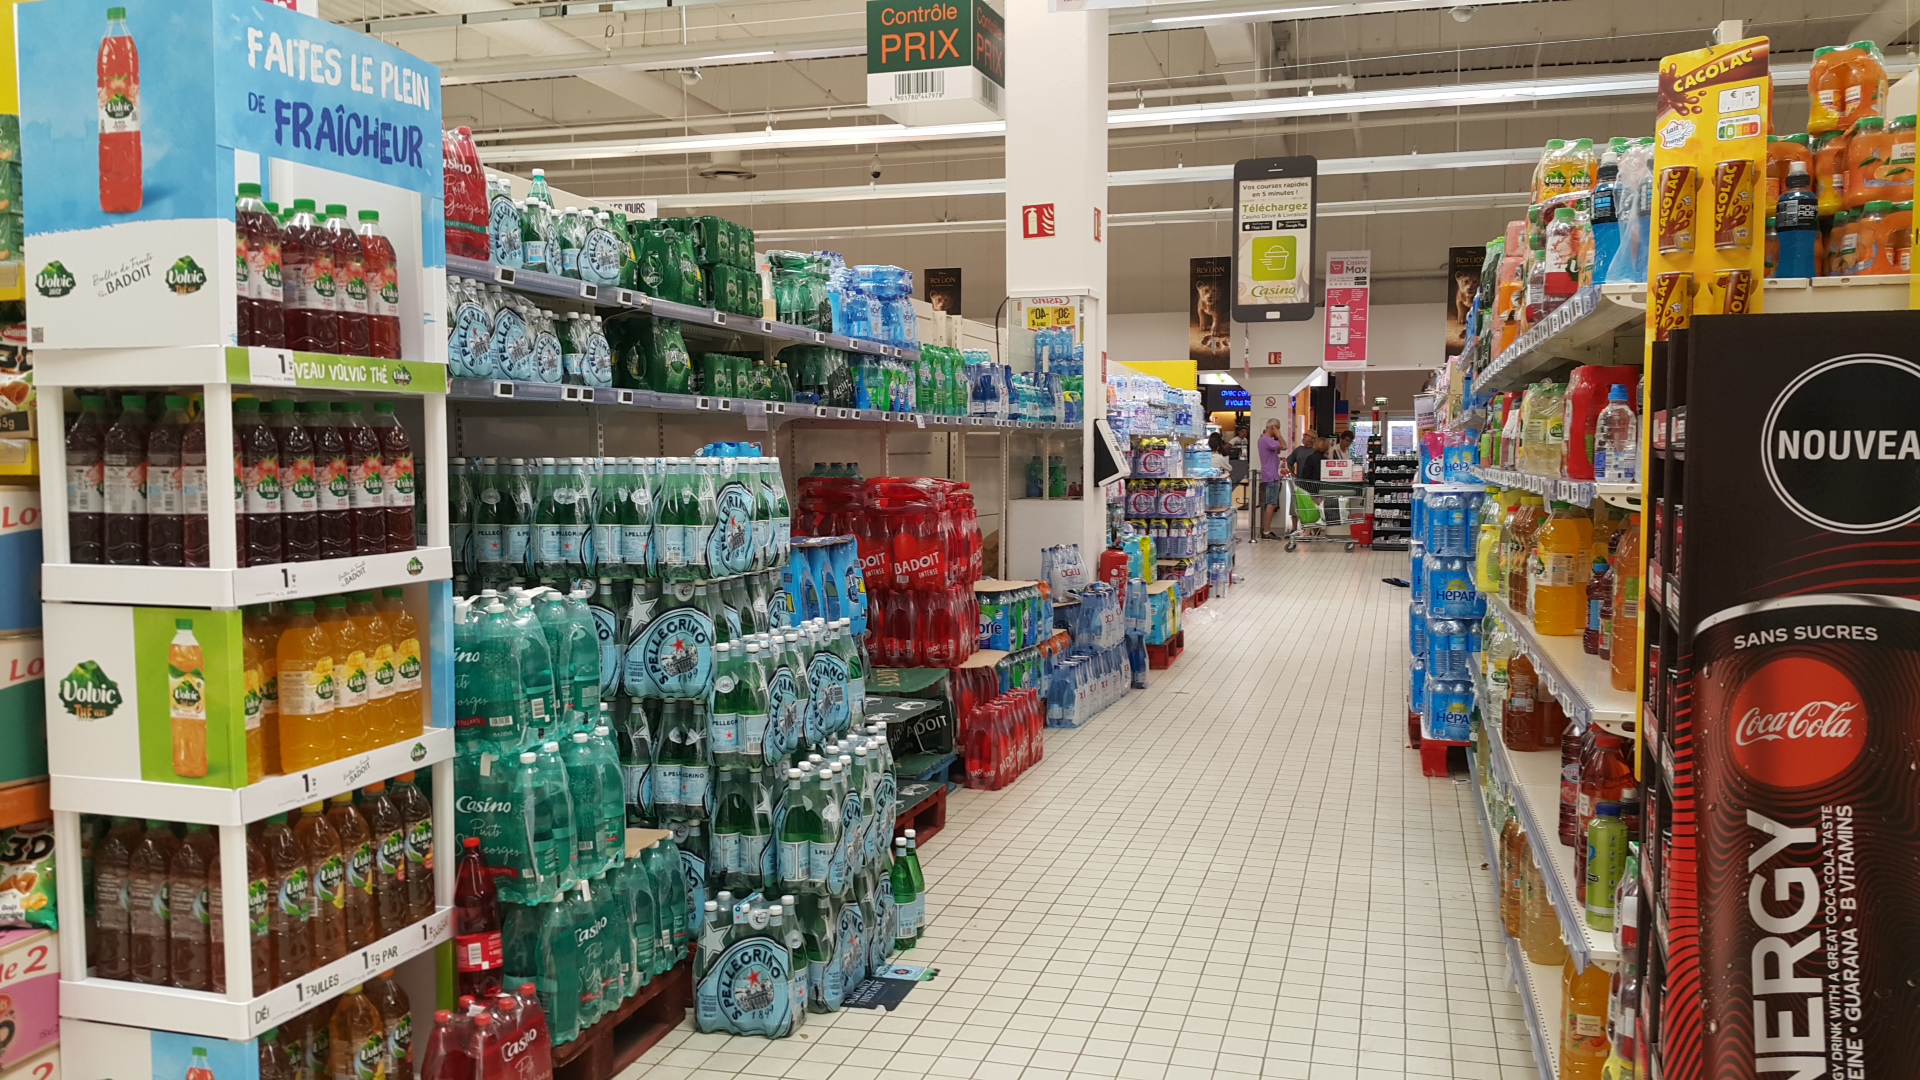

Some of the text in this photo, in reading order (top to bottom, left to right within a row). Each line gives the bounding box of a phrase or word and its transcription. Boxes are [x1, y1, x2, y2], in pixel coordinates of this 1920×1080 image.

[881, 3, 957, 26] Contrôle
[881, 28, 960, 64] PRIX
[976, 32, 1003, 78] PRIX
[247, 27, 430, 110] FAITES LE PLEIN
[1673, 49, 1753, 93] CACOLAC
[248, 92, 423, 168] DE FRAÎCHEUR
[1666, 125, 1679, 134] Lait
[1727, 126, 1734, 136] B
[1283, 181, 1308, 189] rapides
[1545, 176, 1565, 185] Volvic
[1571, 176, 1591, 185] Volvic
[1242, 202, 1308, 214] Téléchargez
[1715, 164, 1738, 232] CACOLAC
[106, 264, 151, 294] BADOIT
[168, 270, 203, 284] Volvic
[1345, 265, 1367, 274] Max
[38, 274, 73, 289] Volvic
[1251, 285, 1296, 298] Casino
[1730, 273, 1750, 314] OLAC
[278, 354, 286, 374] 1
[329, 365, 367, 383] VOLVIC
[370, 365, 388, 384] THÉ
[1777, 429, 1920, 460] NOUVEA
[3, 506, 41, 529] LO
[894, 552, 940, 575] BADOIT
[918, 568, 938, 579] INTENSE
[281, 569, 288, 588] 1
[1733, 624, 1879, 650] SANS SUCRES
[648, 618, 706, 685] S.PELLEGRINO
[677, 668, 698, 683] 1899
[63, 680, 117, 704] Volvic
[174, 690, 198, 700] Volvic
[74, 704, 93, 719] THÉ
[1736, 701, 1859, 746] Coca-Cola
[302, 774, 309, 792] 1
[456, 795, 512, 813] Casino
[470, 819, 502, 838] Puits
[1821, 805, 1834, 847] TASTE
[484, 843, 522, 864] eorges
[1836, 804, 1856, 895] VITAMINS
[1841, 897, 1857, 910] B
[24, 945, 48, 974] 2
[382, 946, 398, 963] PAR
[1826, 929, 1840, 971] GREAT
[722, 948, 780, 1020] S.PELLEGRINO
[1828, 972, 1839, 982] A
[1843, 927, 1862, 1022] GUARANA
[296, 983, 303, 1002] 1
[1829, 984, 1841, 1020] WITH
[255, 1005, 270, 1025] DÉ
[752, 1005, 774, 1018] 1899
[1831, 1022, 1843, 1061] DRINK
